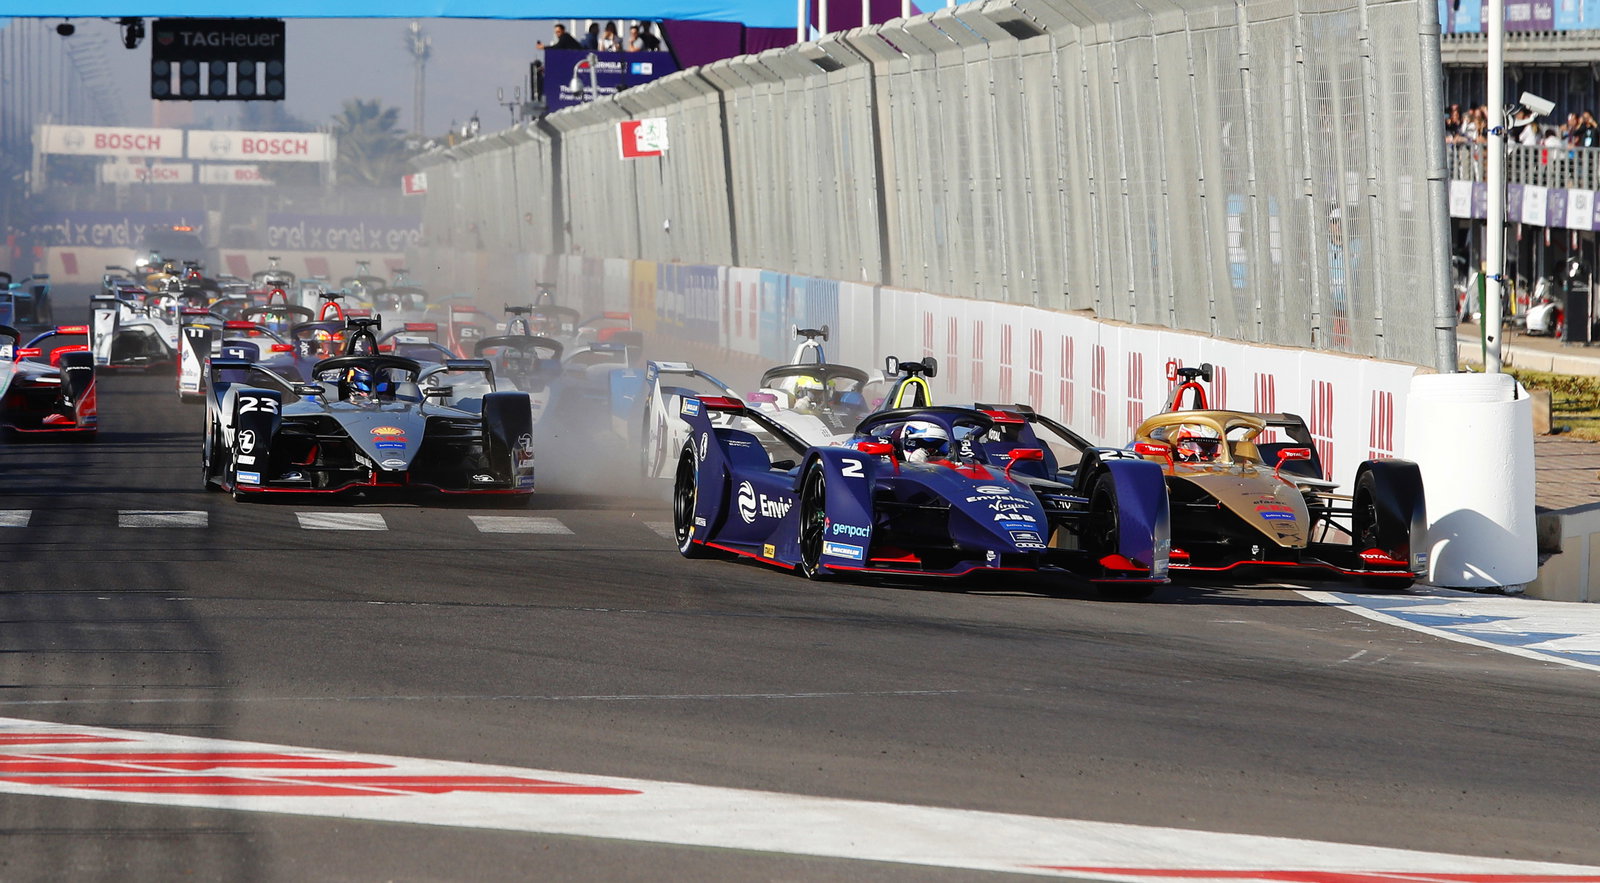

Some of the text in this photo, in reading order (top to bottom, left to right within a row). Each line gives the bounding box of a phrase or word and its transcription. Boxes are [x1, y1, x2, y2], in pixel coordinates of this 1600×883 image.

[94, 133, 161, 150] BOSCH
[242, 137, 308, 155] BOSCH
[189, 328, 204, 338] 11
[229, 349, 245, 359] 4
[239, 396, 279, 415] 23
[841, 458, 865, 478] 2
[966, 495, 1034, 506] Envision
[988, 500, 1029, 513] Virgin
[993, 513, 1037, 522] ABB
[832, 523, 870, 538] genpact
